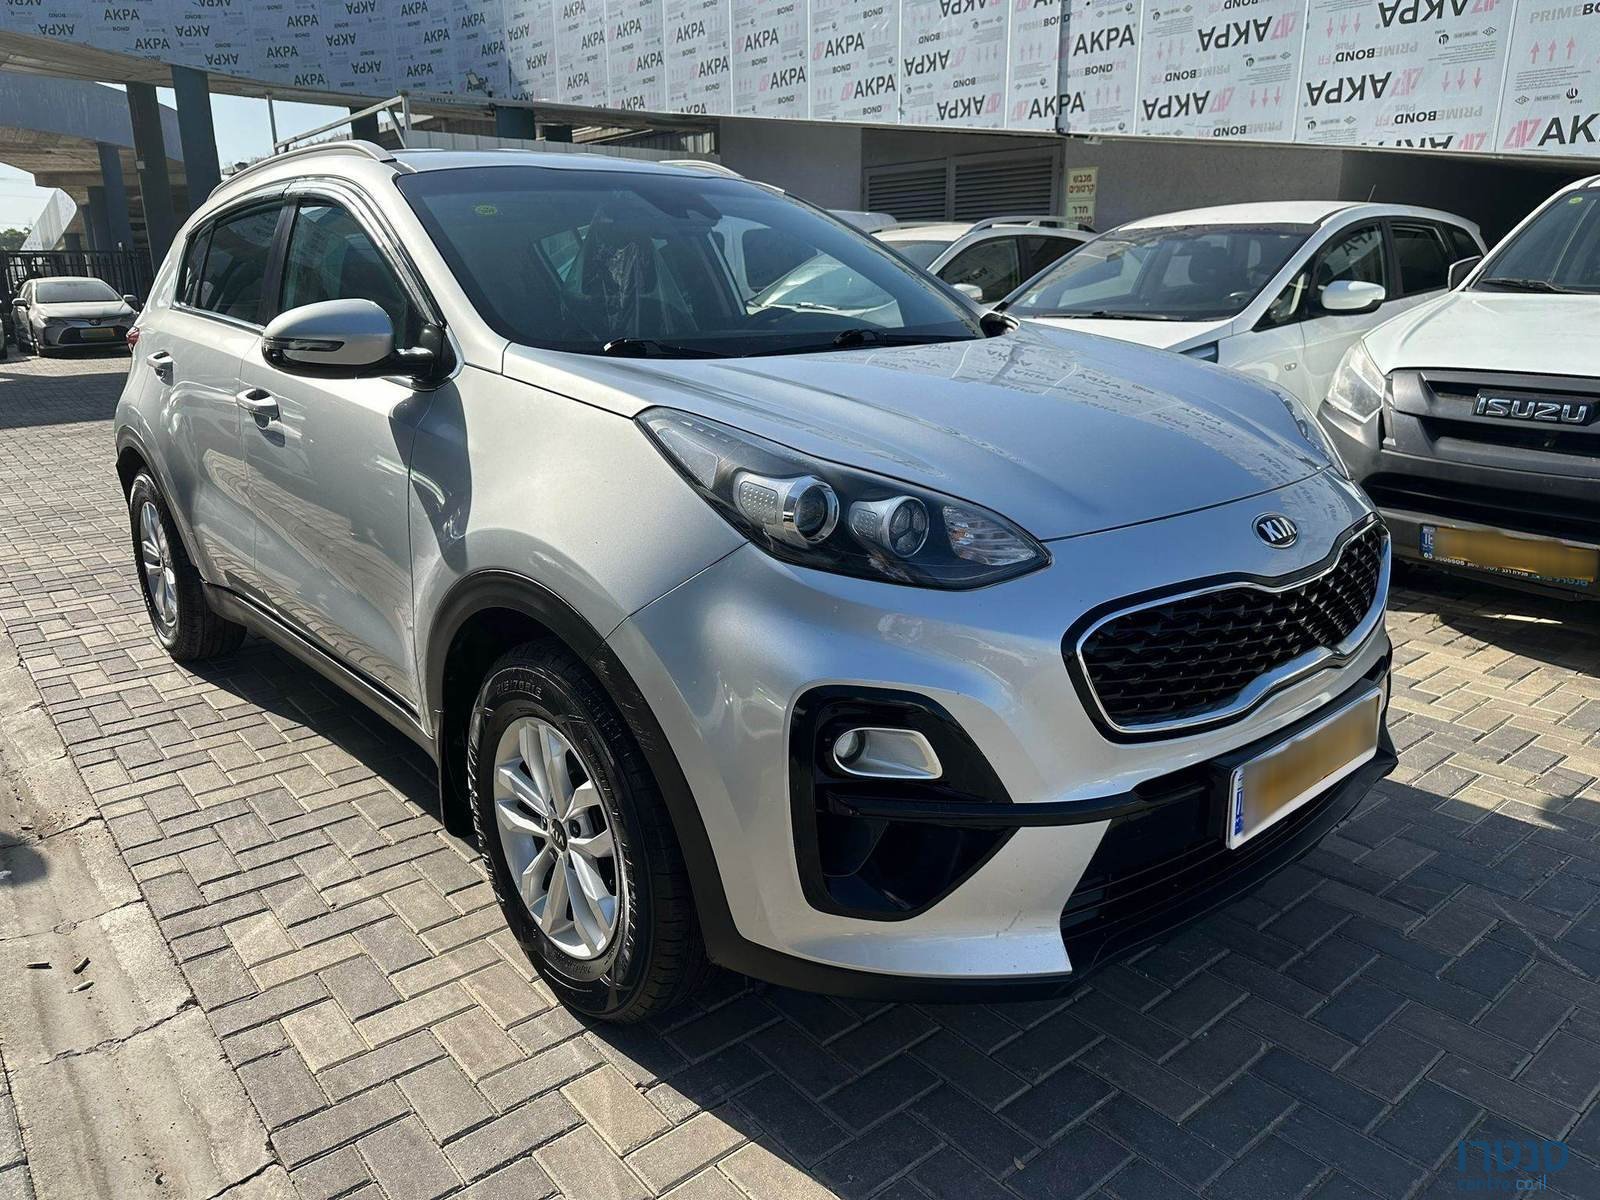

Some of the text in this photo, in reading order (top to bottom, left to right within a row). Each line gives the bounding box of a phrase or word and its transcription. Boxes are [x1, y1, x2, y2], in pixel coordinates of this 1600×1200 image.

[104, 8, 140, 20] AKPA
[345, 0, 376, 15] AKPA
[401, 2, 428, 16] AKPA
[563, 0, 586, 19] AKPA
[38, 24, 75, 35] AKPA
[287, 15, 319, 28] AKPA
[461, 13, 486, 29] AKPA
[616, 18, 642, 39] AKPA
[175, 25, 210, 37] AKPA
[326, 32, 356, 46] AKPA
[424, 28, 450, 43] AKPA
[508, 23, 530, 41] AKPA
[581, 31, 605, 50] AKPA
[676, 20, 706, 43] AKPA
[744, 28, 779, 52] AKPA
[1073, 24, 1135, 57] AKPA
[1198, 16, 1273, 51] AKPA
[135, 37, 170, 49] AKPA
[267, 46, 298, 58] AKPA
[481, 40, 505, 57] AKPA
[824, 32, 865, 58] AKPA
[205, 53, 239, 65] AKPA
[351, 60, 381, 74] AKPA
[526, 51, 549, 70] AKPA
[636, 51, 664, 71] AKPA
[698, 56, 729, 78] AKPA
[904, 50, 950, 77] AKPA
[294, 73, 325, 86] AKPA
[407, 63, 433, 78] AKPA
[770, 66, 806, 90] AKPA
[567, 72, 590, 90] AKPA
[854, 74, 896, 99] AKPA
[1306, 72, 1392, 106] AKPA
[937, 94, 985, 120] AKPA
[1029, 92, 1085, 120] AKPA
[1143, 91, 1210, 121] AKPA
[1538, 113, 1600, 147] AK
[1476, 396, 1588, 423] ISUZU
